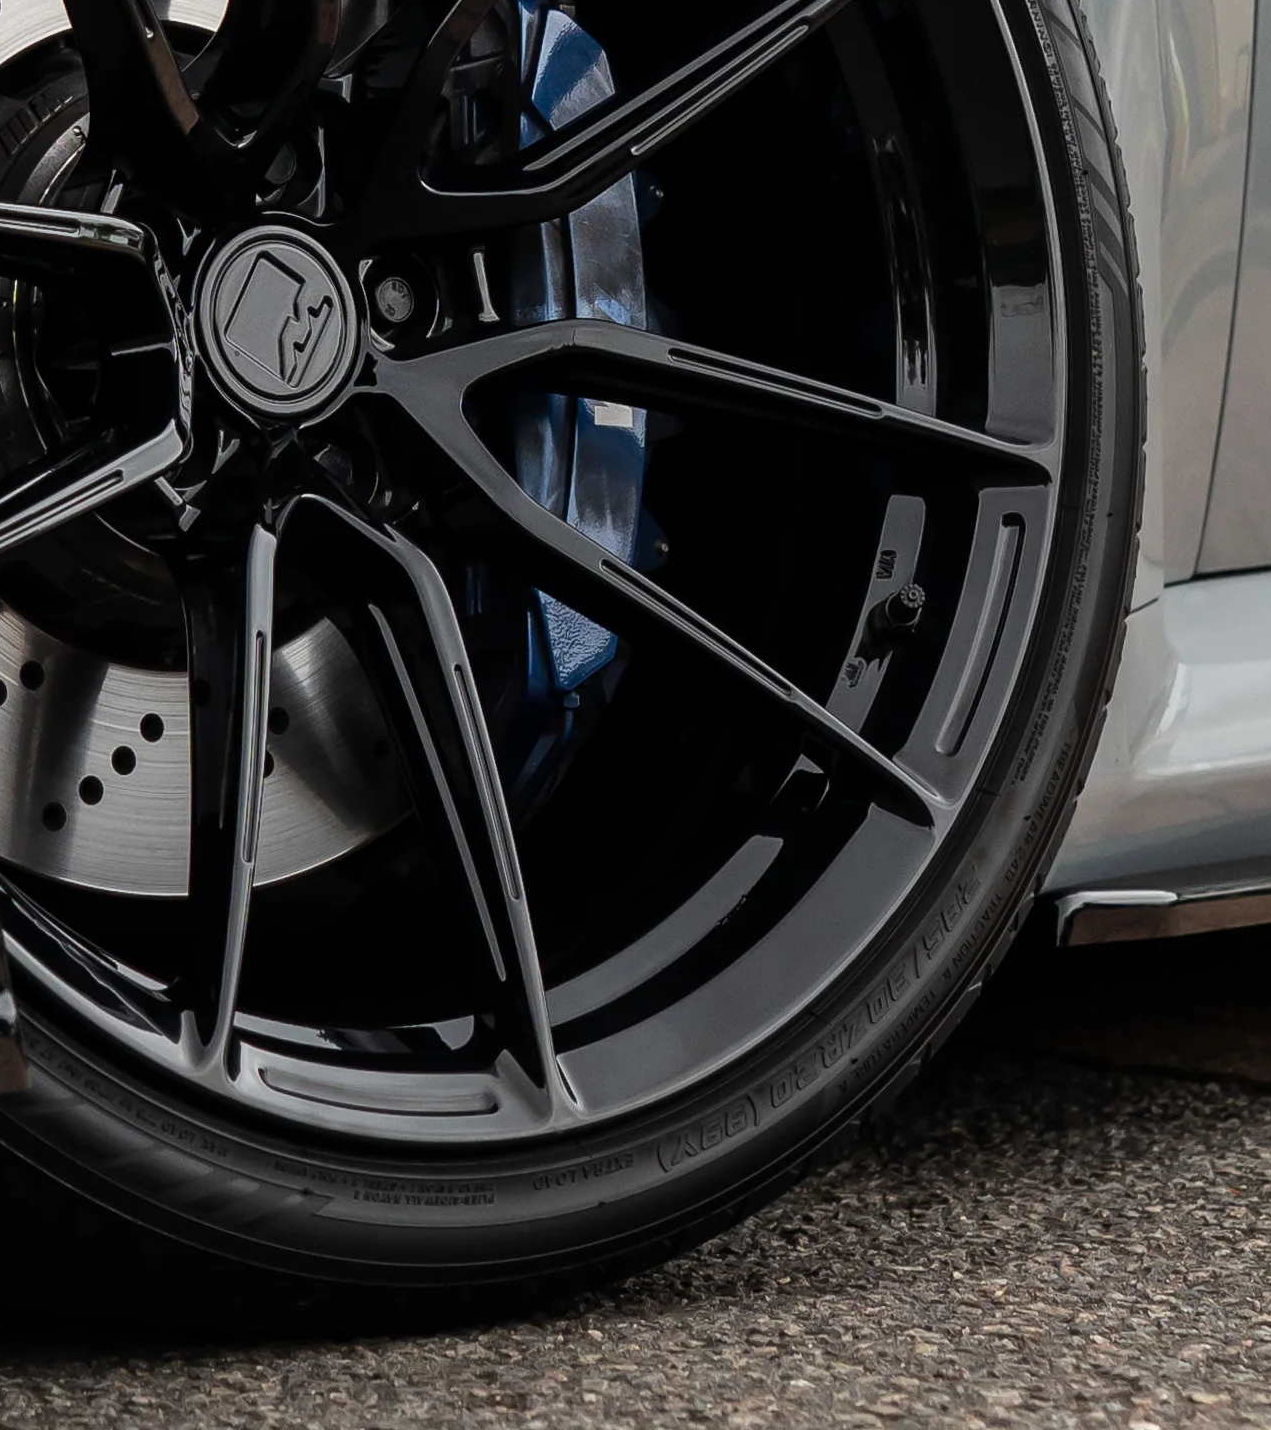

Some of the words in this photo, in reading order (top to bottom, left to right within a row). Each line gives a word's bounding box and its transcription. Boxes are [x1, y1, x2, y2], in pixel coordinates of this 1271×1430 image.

[1020, 739, 1074, 846] TREADWEAR
[1002, 844, 1028, 884] 240
[949, 890, 1004, 969] TRACTION
[848, 987, 939, 1084] TEMPERATURE
[530, 1167, 579, 1193] LOAD
[579, 1149, 636, 1182] EXTRA
